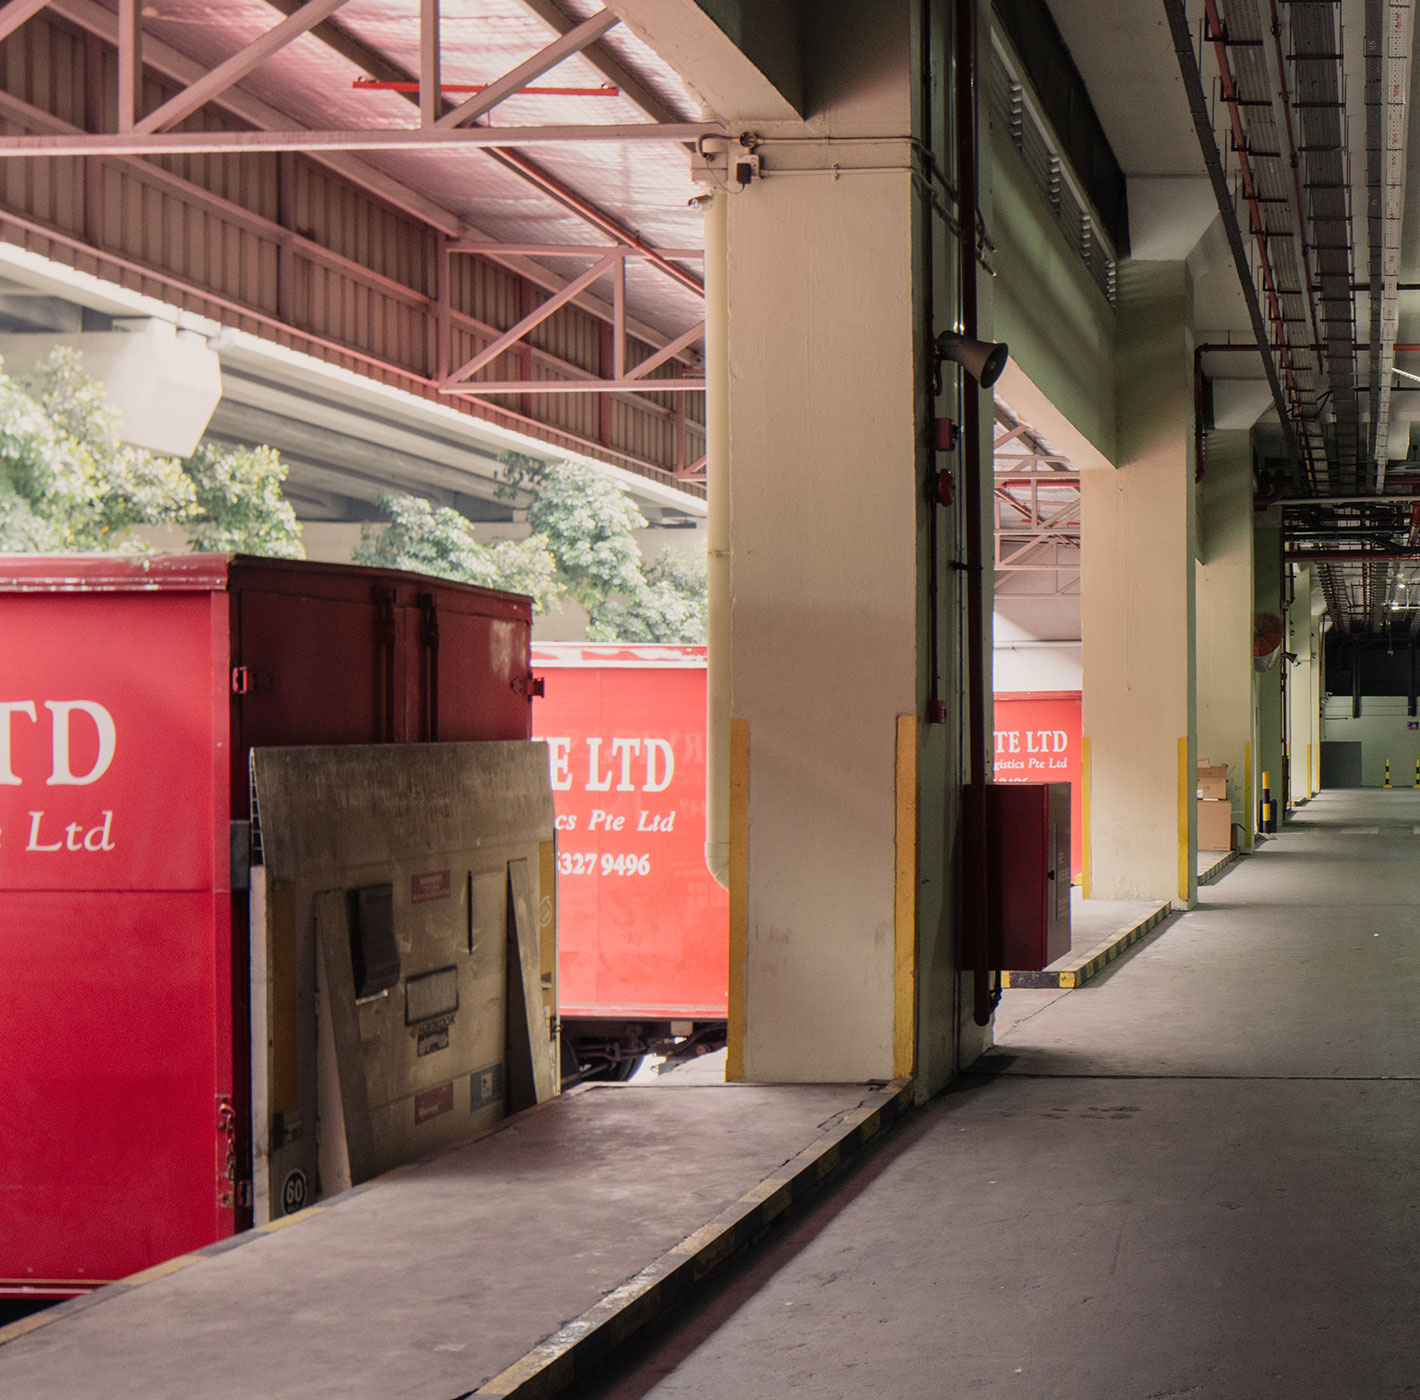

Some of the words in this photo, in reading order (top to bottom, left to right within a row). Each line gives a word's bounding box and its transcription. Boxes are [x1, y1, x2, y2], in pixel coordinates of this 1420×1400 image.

[1026, 730, 1068, 753] LTD
[585, 737, 675, 792] LTD
[1028, 757, 1046, 769] Pte
[1049, 757, 1068, 769] Ltd
[25, 810, 116, 852] Ltd
[588, 809, 626, 832] Pte
[637, 810, 676, 832] Ltd
[557, 852, 597, 876] 327
[601, 853, 651, 877] 9496
[286, 1178, 303, 1205] 60
